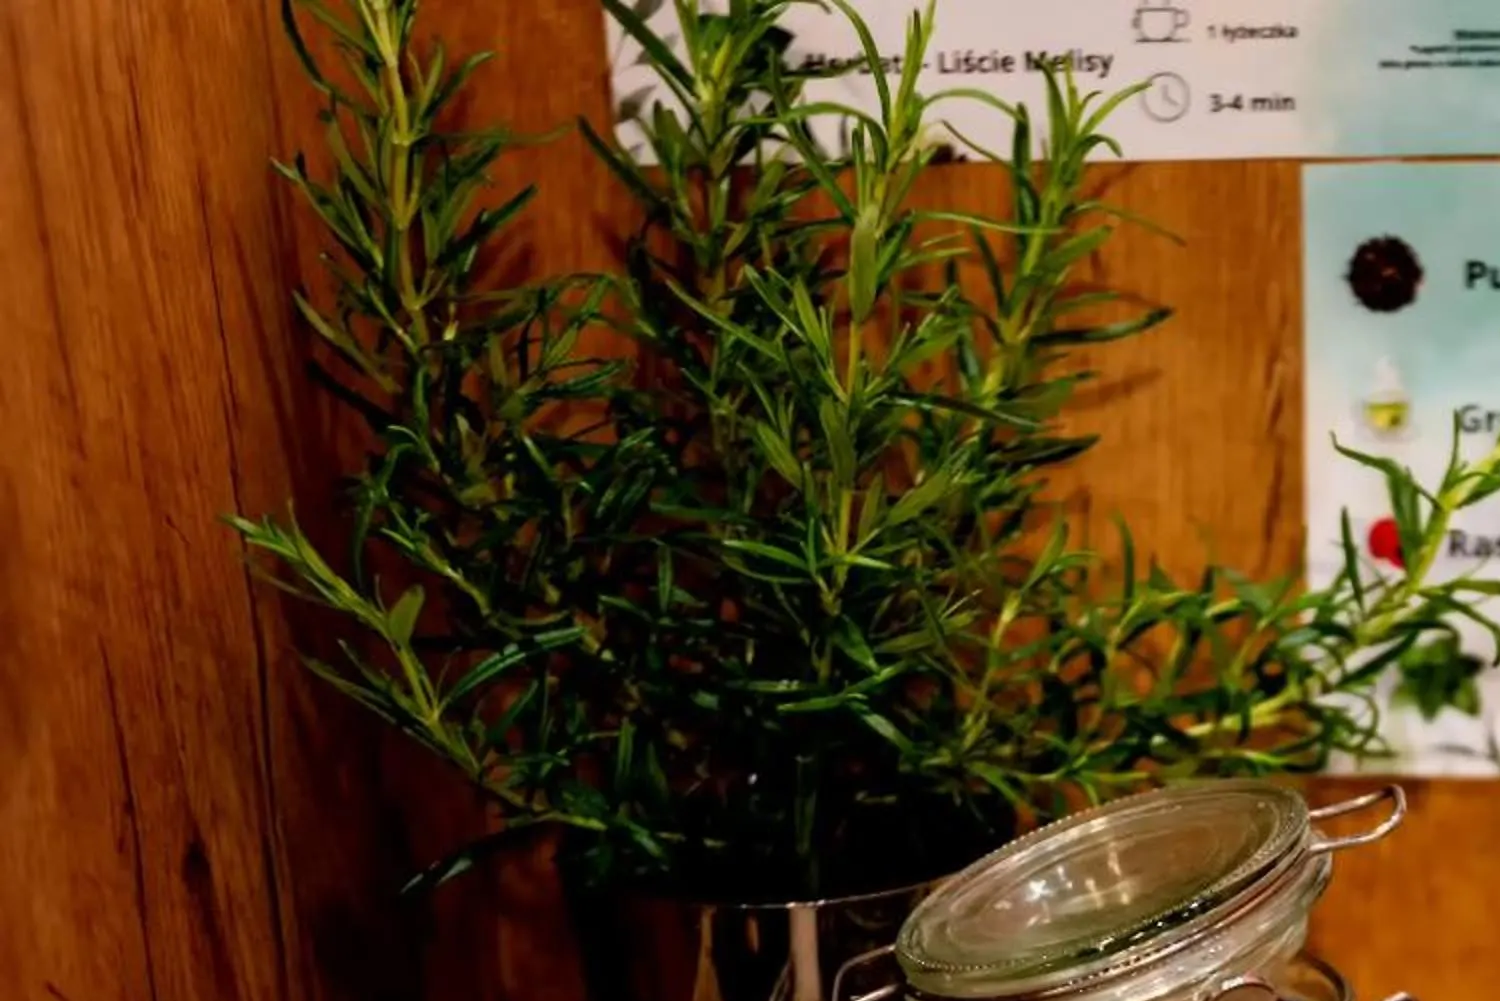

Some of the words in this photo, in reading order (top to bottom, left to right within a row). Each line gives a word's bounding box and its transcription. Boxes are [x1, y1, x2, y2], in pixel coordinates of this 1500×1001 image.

[938, 50, 1016, 73] Liście
[1209, 93, 1243, 112] 3-4
[1250, 94, 1296, 112] min
